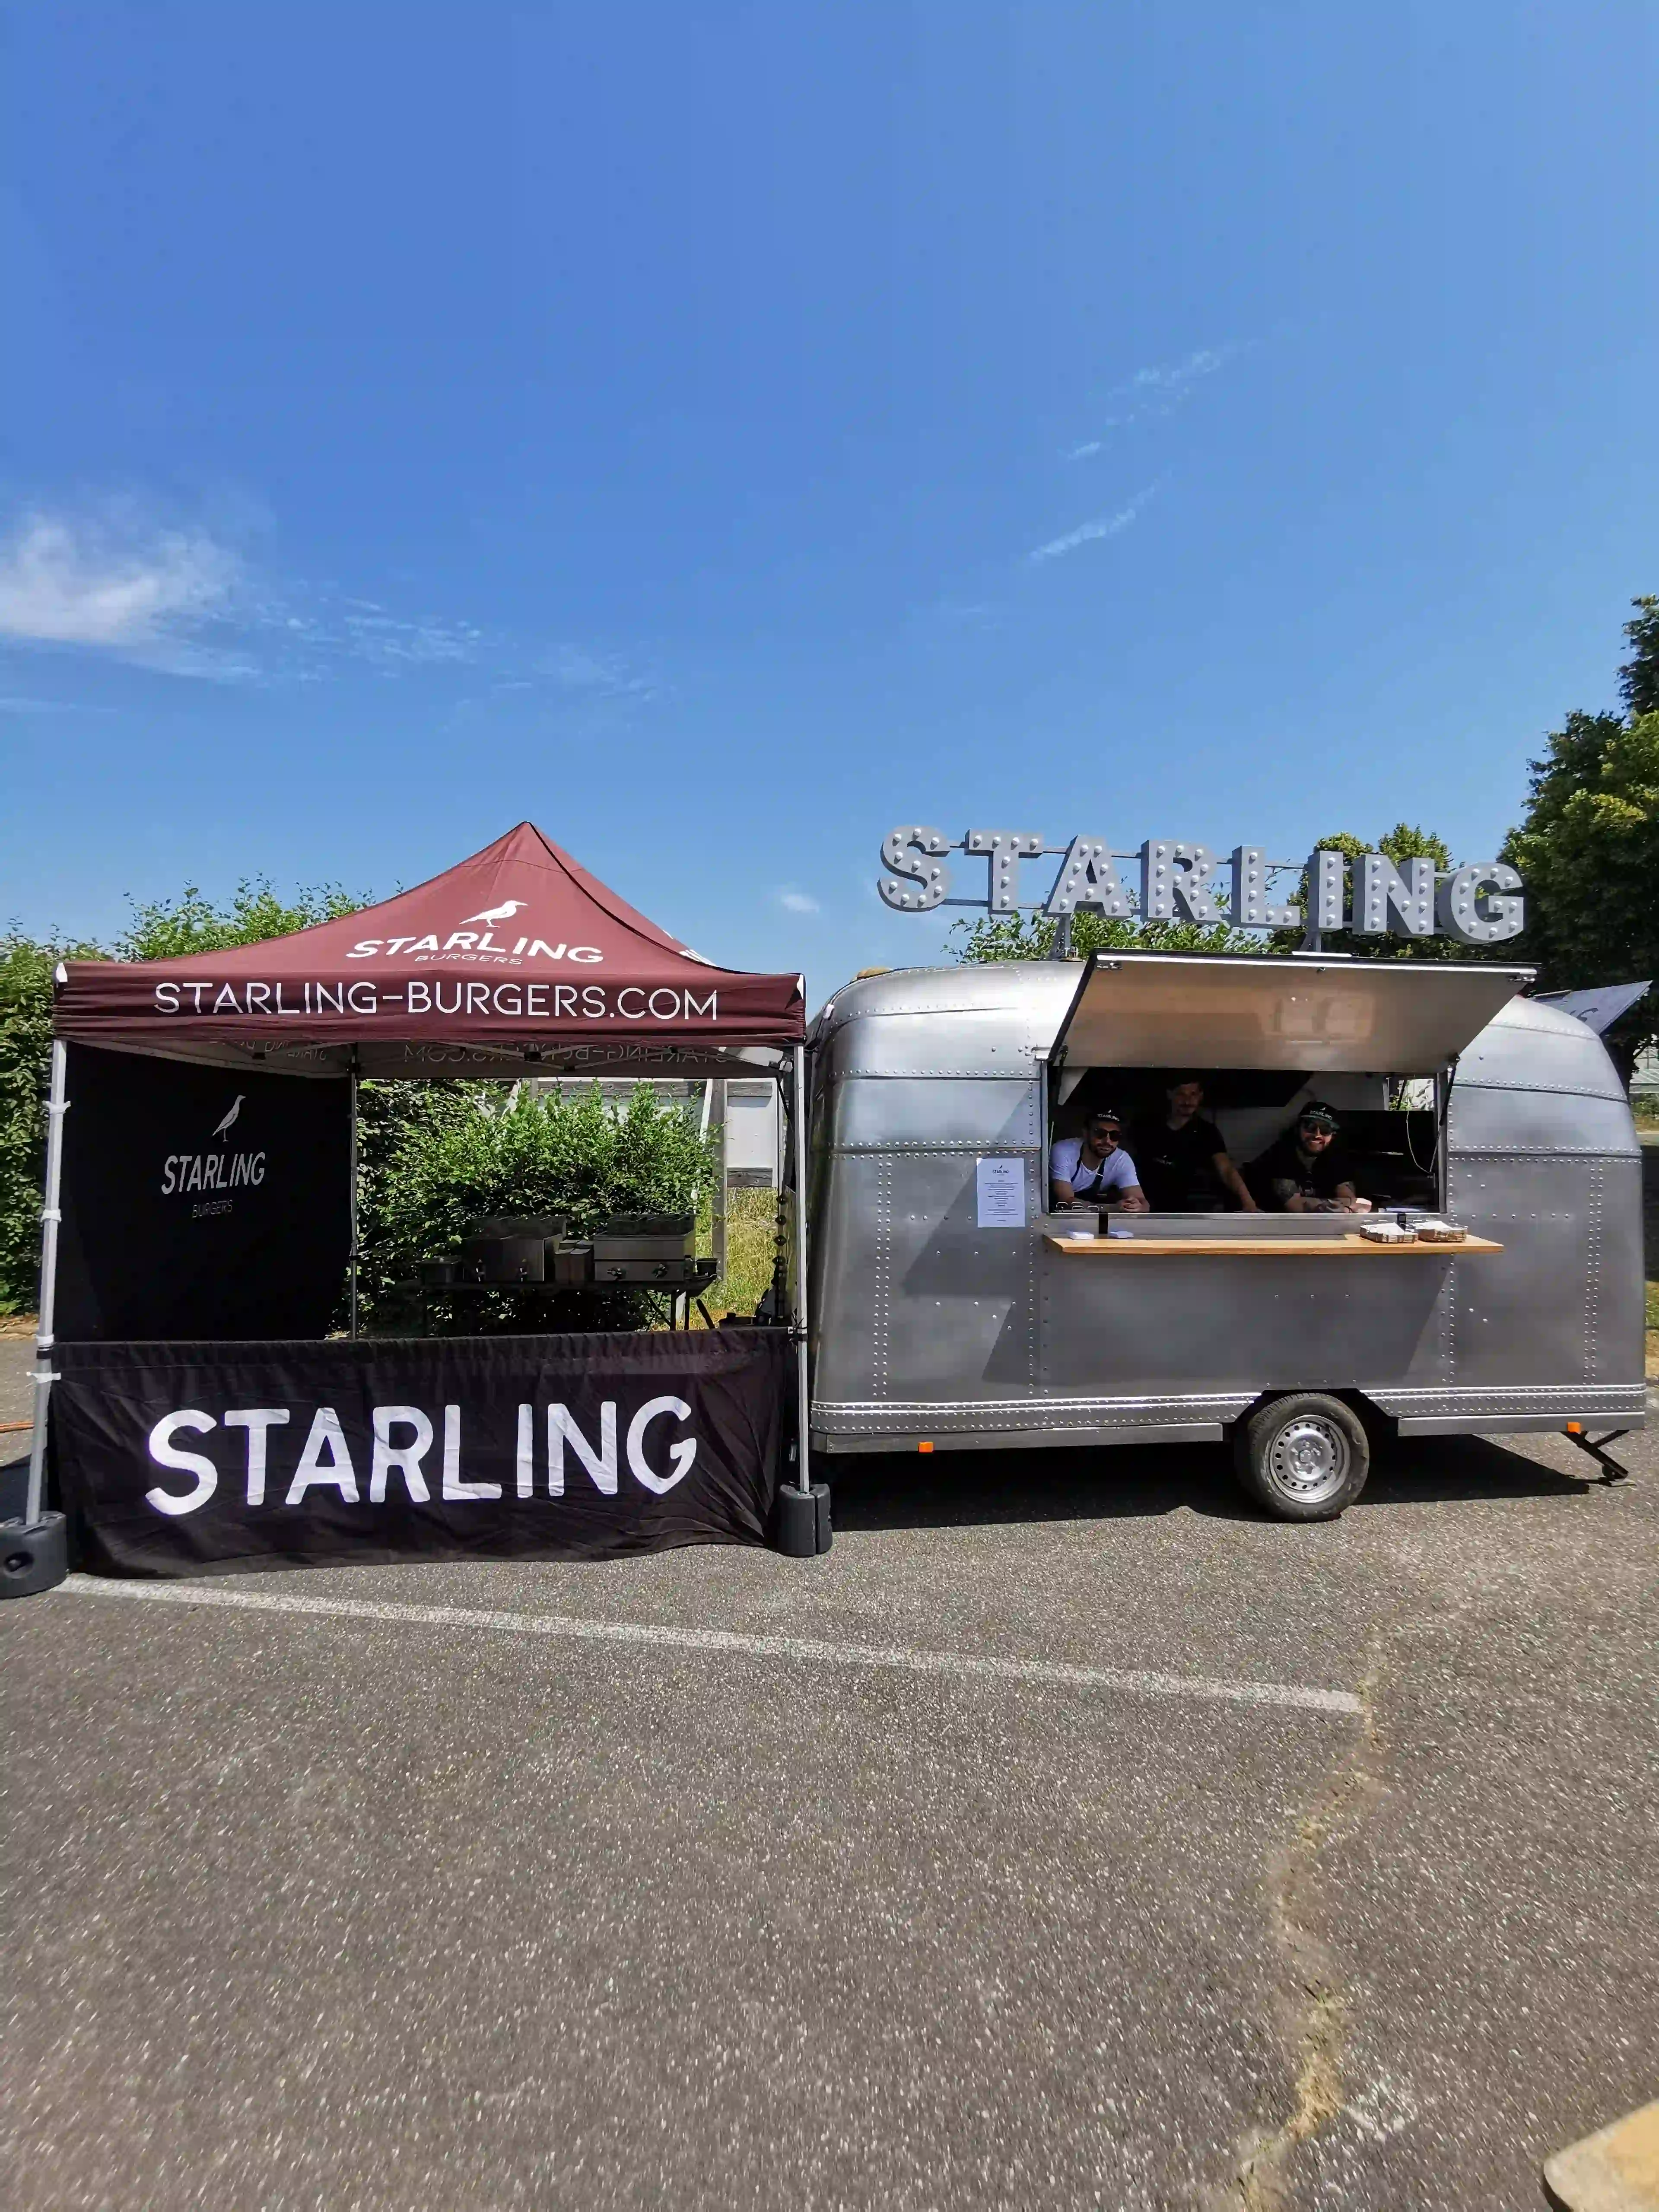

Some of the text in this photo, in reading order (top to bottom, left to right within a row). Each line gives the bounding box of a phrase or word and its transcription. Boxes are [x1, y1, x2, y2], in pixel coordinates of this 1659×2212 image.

[877, 825, 1524, 944] STARLING
[346, 932, 604, 963] STARLING
[414, 953, 523, 964] BURGERS
[154, 982, 717, 1020] STARLING-BURGERS.COM
[161, 1152, 266, 1195] STARLING
[145, 1396, 697, 1515] STARLING
